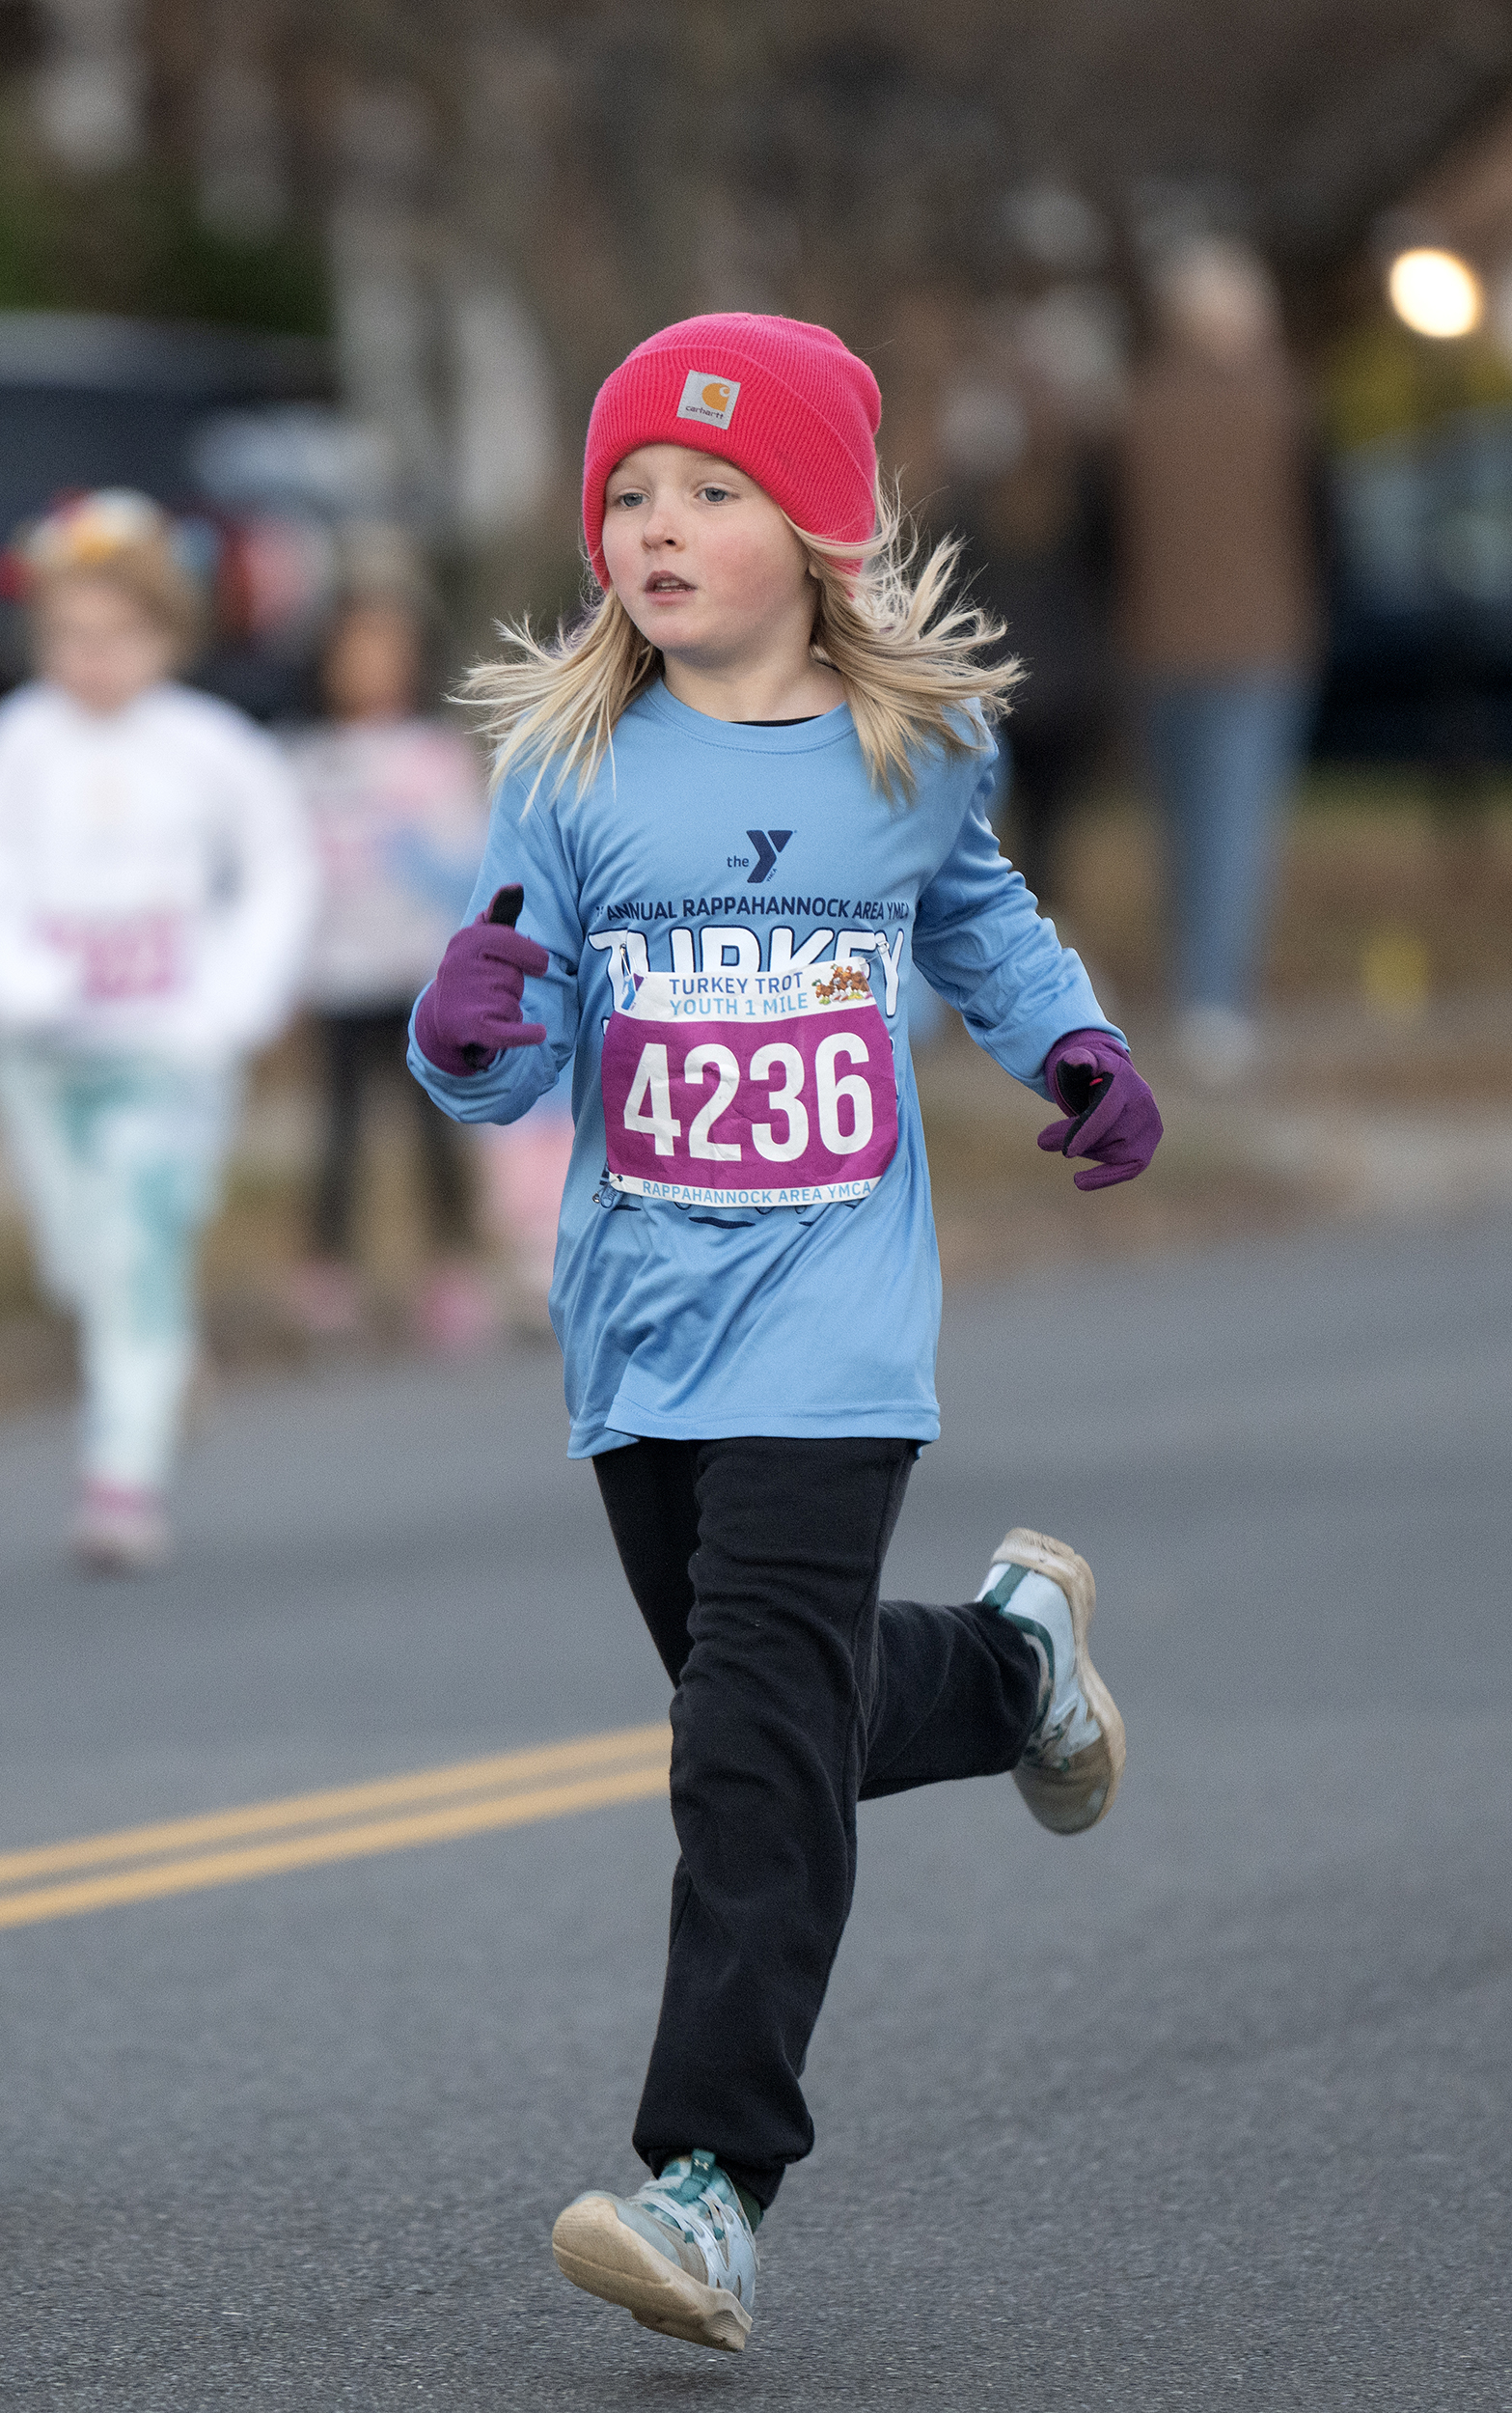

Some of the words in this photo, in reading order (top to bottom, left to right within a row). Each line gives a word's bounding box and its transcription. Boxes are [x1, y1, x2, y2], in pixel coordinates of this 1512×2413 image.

[685, 405, 724, 419] carhartt
[727, 855, 750, 868] the
[746, 830, 794, 883] Y
[607, 900, 677, 921] ANNUAL
[682, 896, 851, 918] RAPPAHANNOCK
[852, 900, 884, 920] AREA
[669, 977, 748, 995] TURKEY
[755, 971, 804, 994] TROT
[669, 998, 738, 1016] YOUTH
[745, 999, 756, 1015] 1
[763, 992, 809, 1015] MILE
[623, 1032, 874, 1163] 4236
[643, 1179, 773, 1204] RAPPAHANNOCK
[778, 1188, 822, 1203] AREA
[826, 1180, 871, 1200] YMCA
